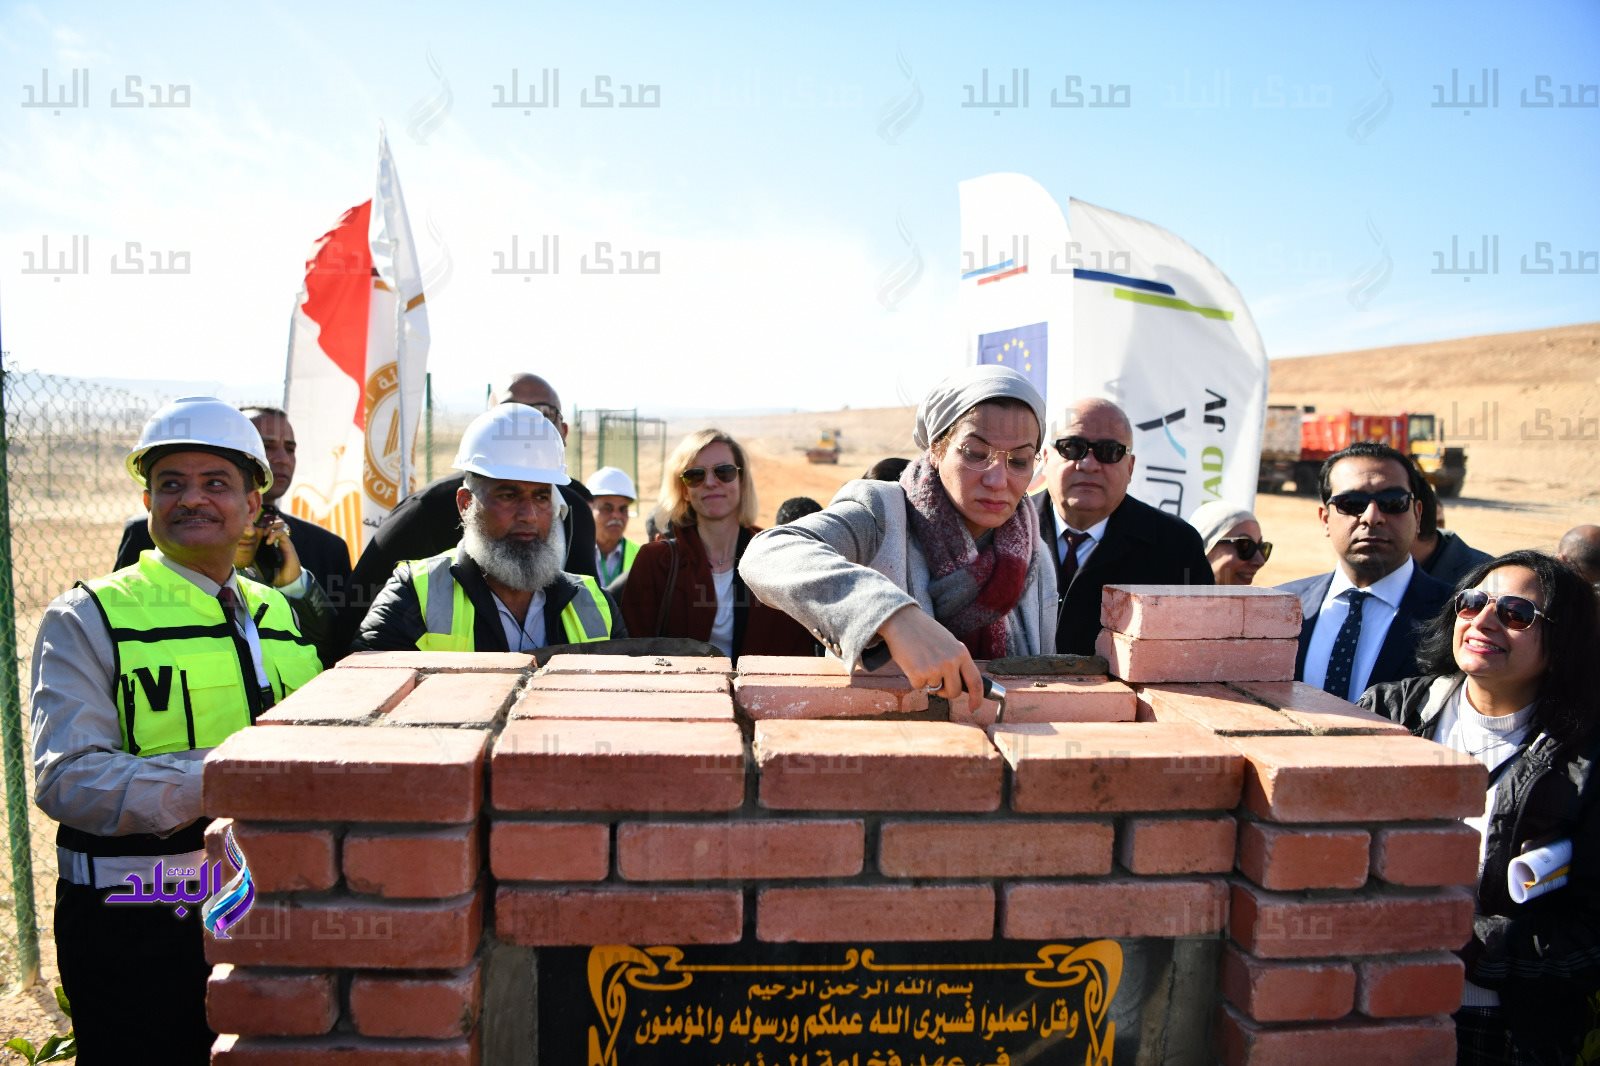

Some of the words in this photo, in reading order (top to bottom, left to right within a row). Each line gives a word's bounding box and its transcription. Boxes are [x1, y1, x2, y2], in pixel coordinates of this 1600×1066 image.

[1203, 388, 1228, 433] JV
[747, 979, 815, 1001] الرحيم
[818, 978, 889, 1000] الرحمن
[893, 976, 933, 997] الله
[937, 979, 974, 1000] بسم
[634, 1003, 724, 1044] والمؤمنون
[729, 1006, 799, 1043] ورسوله
[803, 1003, 863, 1044] عملكم
[869, 1003, 909, 1035] الله
[914, 1000, 975, 1045] فسيرى
[982, 1001, 1037, 1041] اعملوا
[1040, 998, 1079, 1039] وقل
